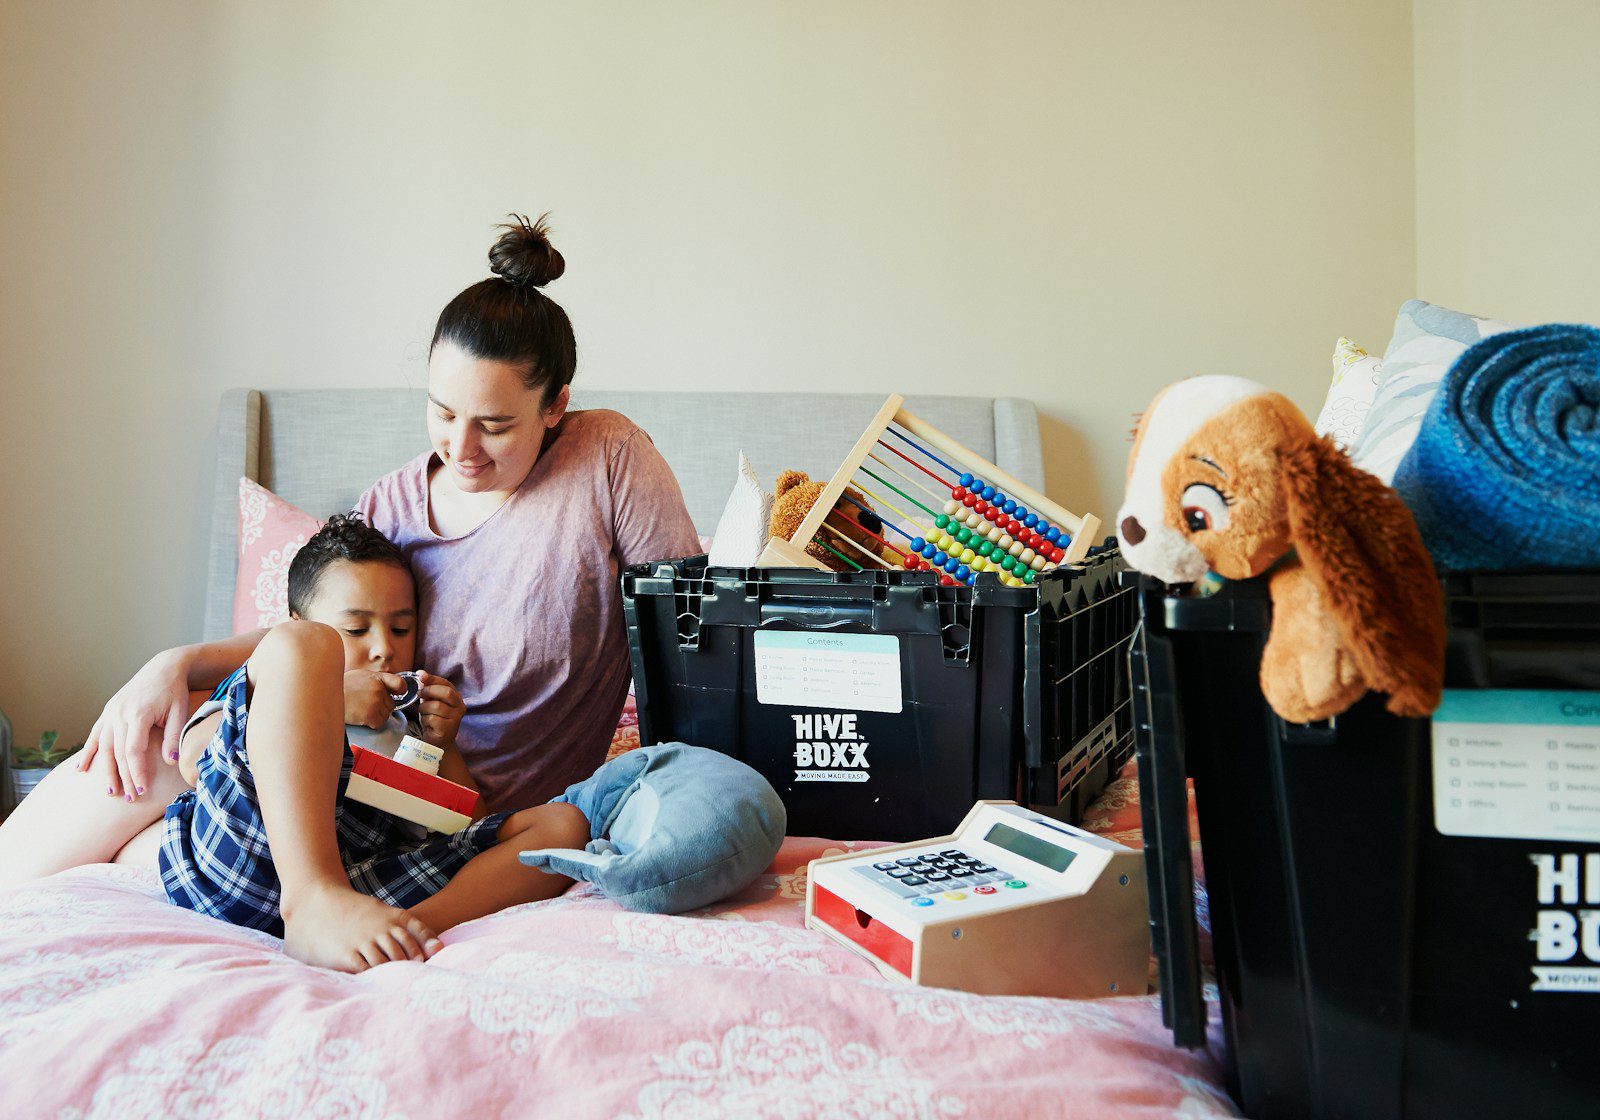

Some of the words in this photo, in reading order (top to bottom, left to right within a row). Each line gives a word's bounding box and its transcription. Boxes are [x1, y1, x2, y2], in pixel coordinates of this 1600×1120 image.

[807, 637, 844, 647] Contents
[791, 713, 858, 740] HIVE
[793, 742, 870, 768] BOXX
